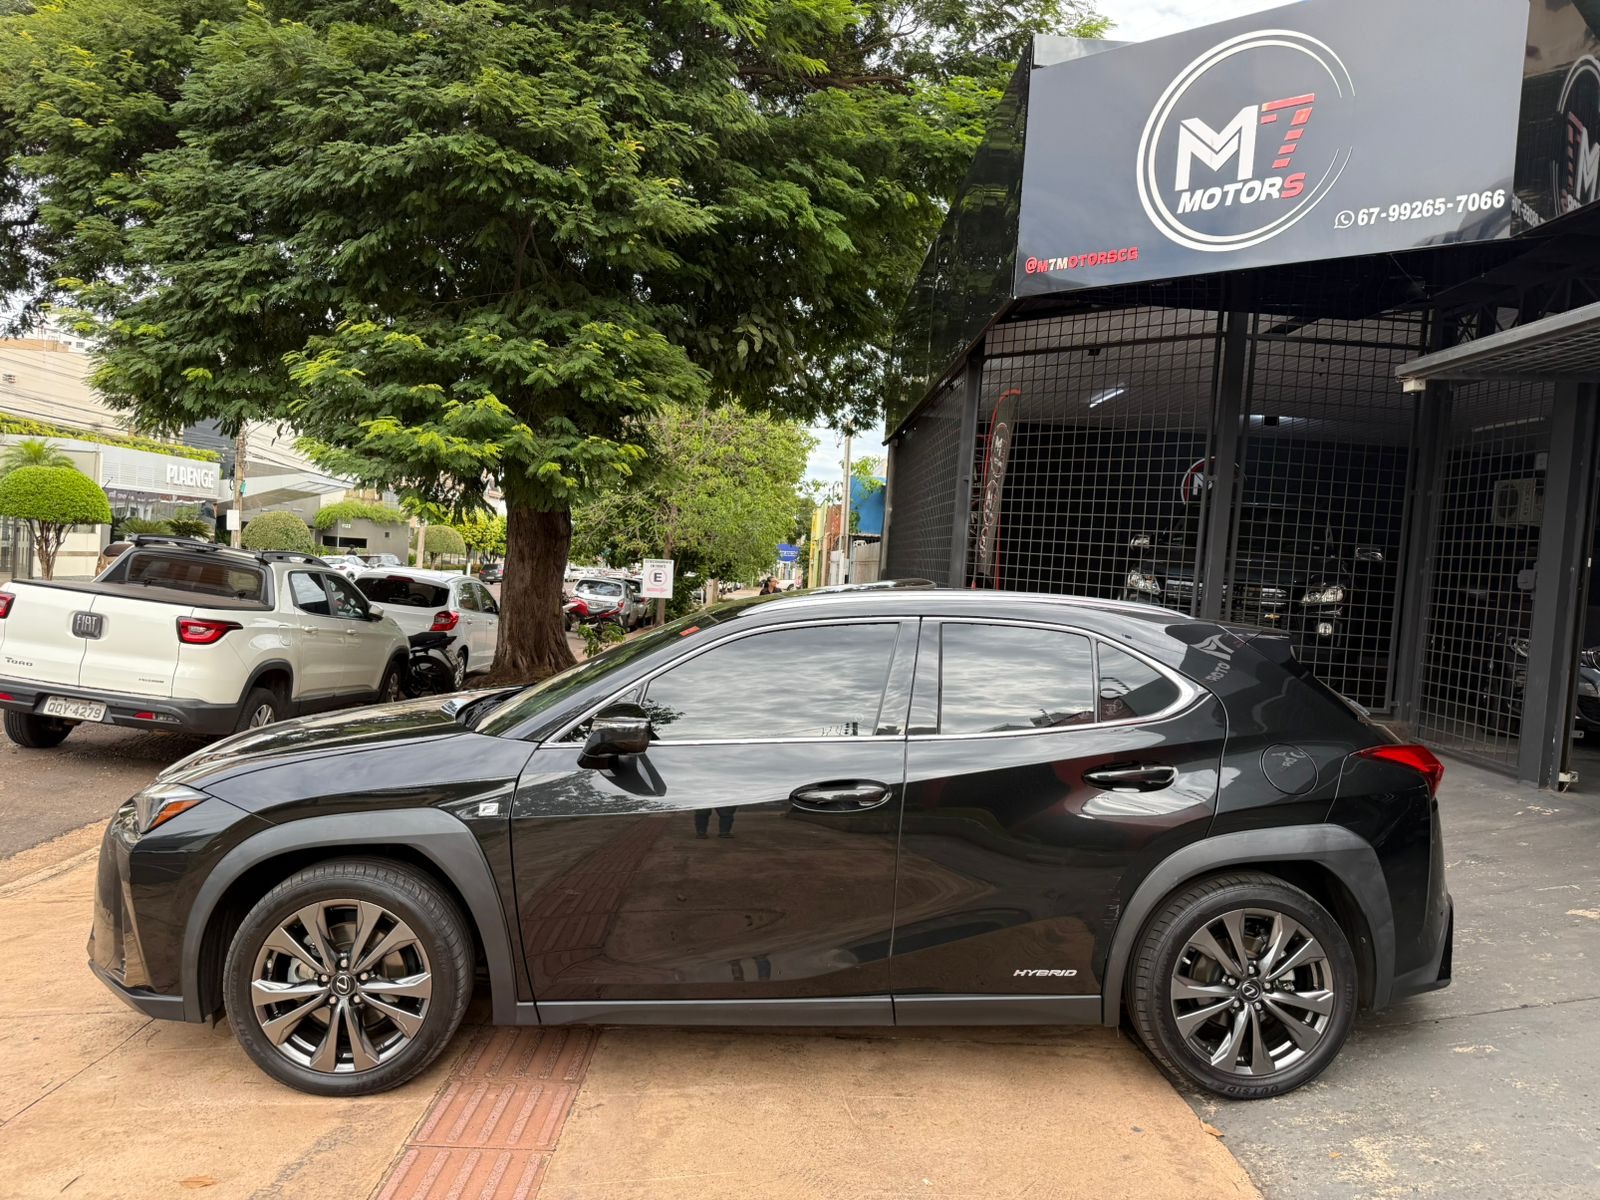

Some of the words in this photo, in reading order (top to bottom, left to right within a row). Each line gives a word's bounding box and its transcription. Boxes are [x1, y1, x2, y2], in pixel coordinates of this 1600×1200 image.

[1175, 93, 1315, 192] M7
[1176, 172, 1307, 214] MOTORS
[1357, 188, 1506, 226] 67-99265-7066
[1025, 246, 1139, 274] @M7MOTORSCG
[166, 463, 214, 489] PLAENGE
[654, 572, 662, 583] E
[76, 614, 98, 633] FIAT
[1013, 969, 1078, 977] HYBRID
